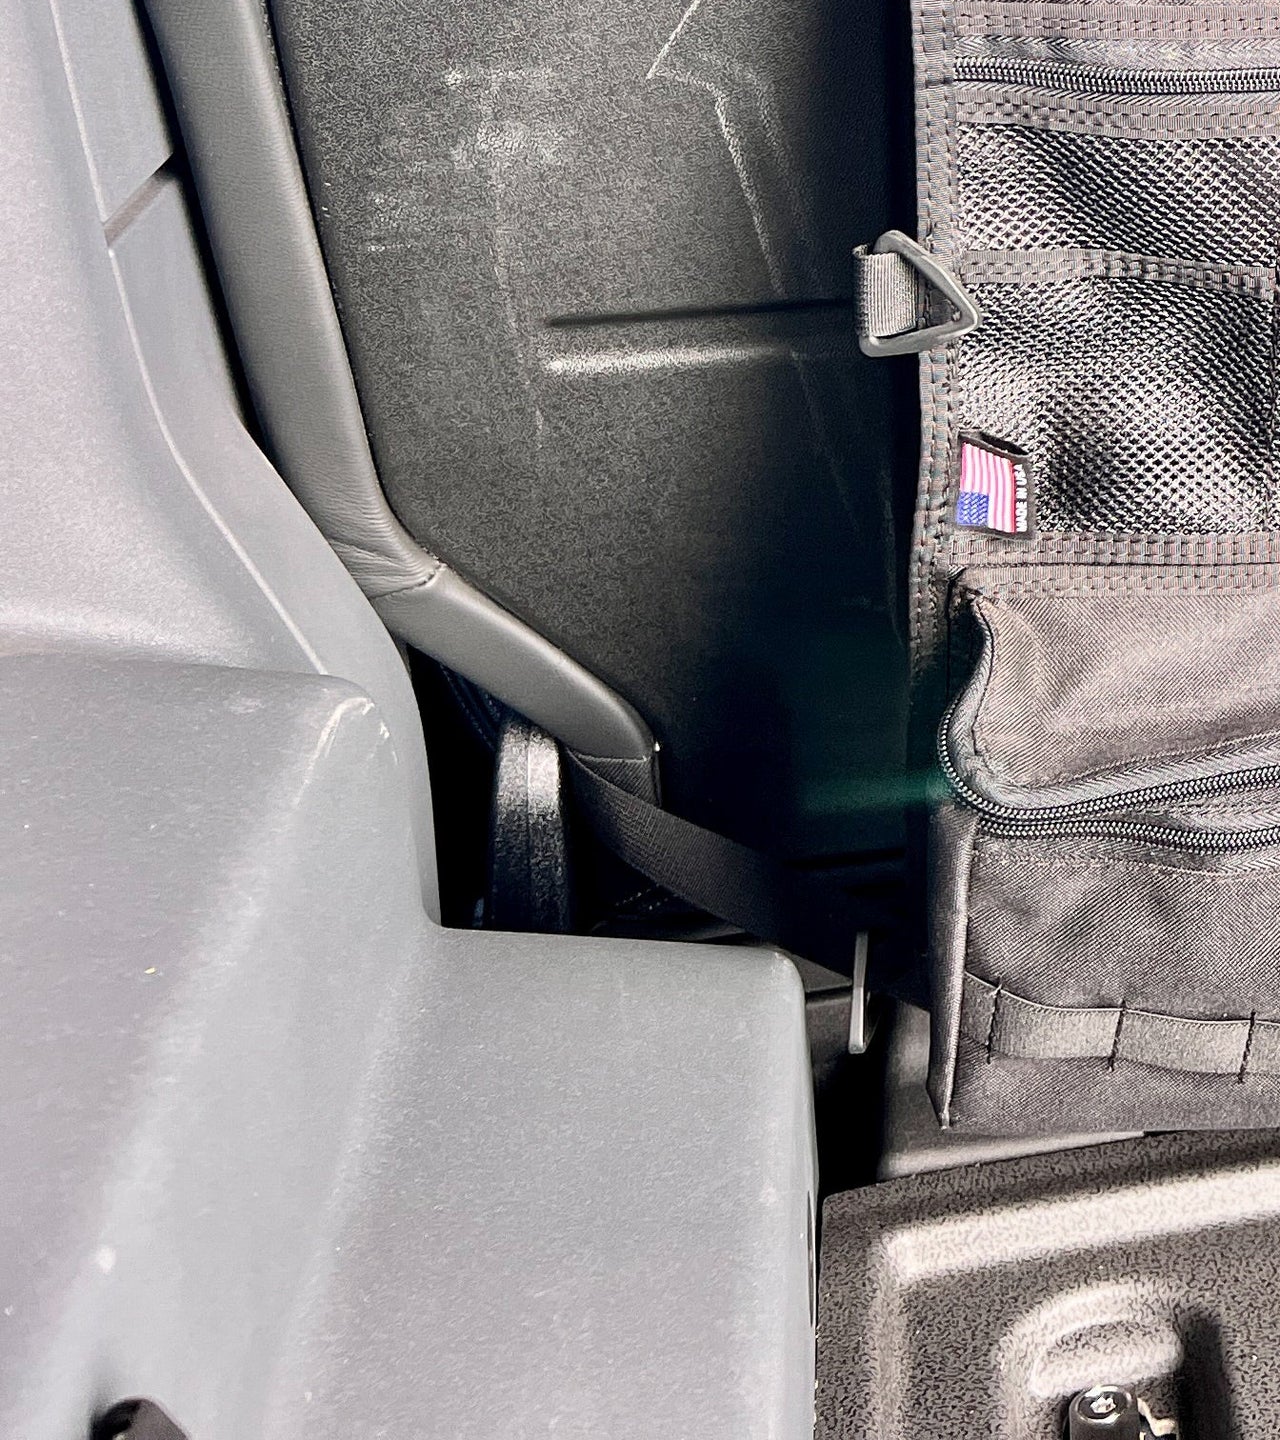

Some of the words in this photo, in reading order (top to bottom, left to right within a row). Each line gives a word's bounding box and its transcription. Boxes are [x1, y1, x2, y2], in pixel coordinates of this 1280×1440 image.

[1013, 464, 1027, 485] USA
[1015, 487, 1027, 499] IN
[1015, 501, 1027, 532] MADE
